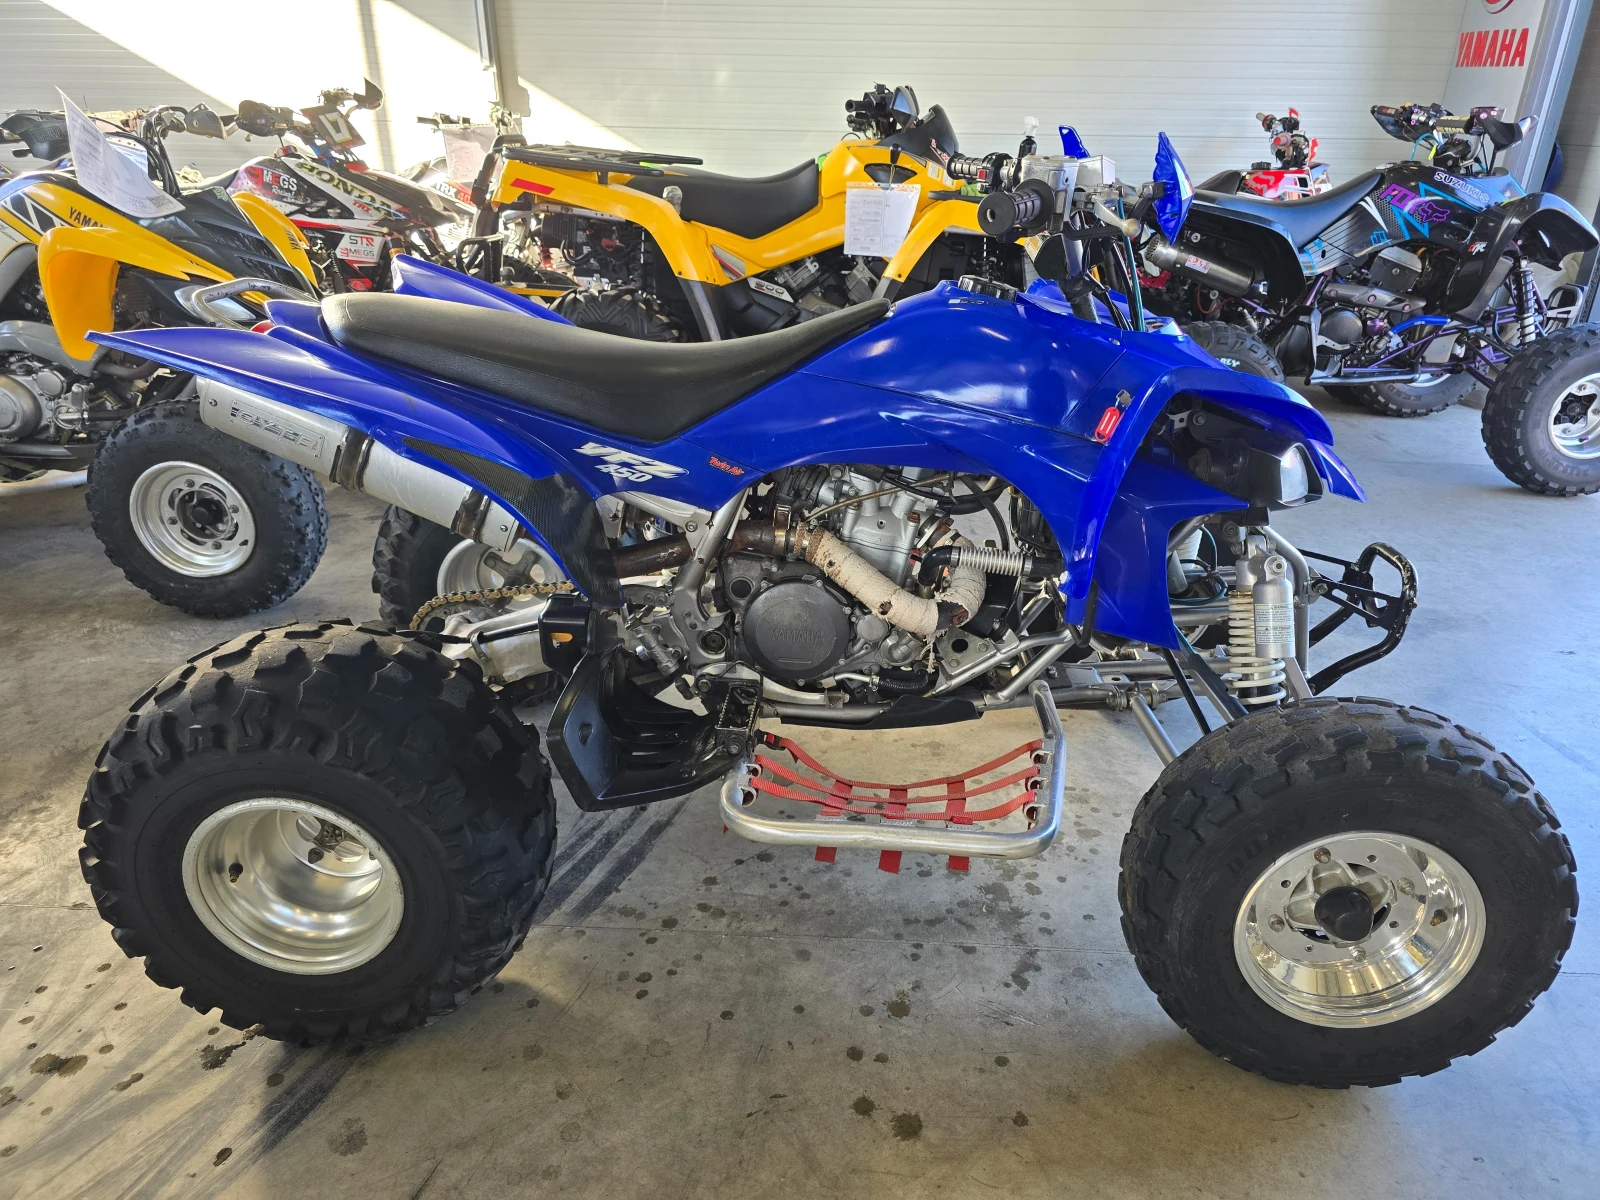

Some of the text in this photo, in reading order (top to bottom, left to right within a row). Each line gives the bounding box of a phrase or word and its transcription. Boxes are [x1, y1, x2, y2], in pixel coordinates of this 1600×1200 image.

[1455, 28, 1529, 67] YAMAHA
[262, 170, 298, 191] MEGS
[294, 161, 397, 221] HONDA
[1434, 171, 1482, 200] SUZUKI
[431, 182, 474, 206] TRX 40
[1380, 184, 1422, 215] FOX
[69, 206, 107, 228] YAMA
[352, 200, 372, 213] TRX
[349, 248, 375, 257] MEGS
[573, 442, 688, 479] YFZ
[710, 456, 730, 471] Twin
[729, 466, 745, 476] Air
[594, 464, 653, 482] 450
[770, 627, 822, 643] YAMAHA
